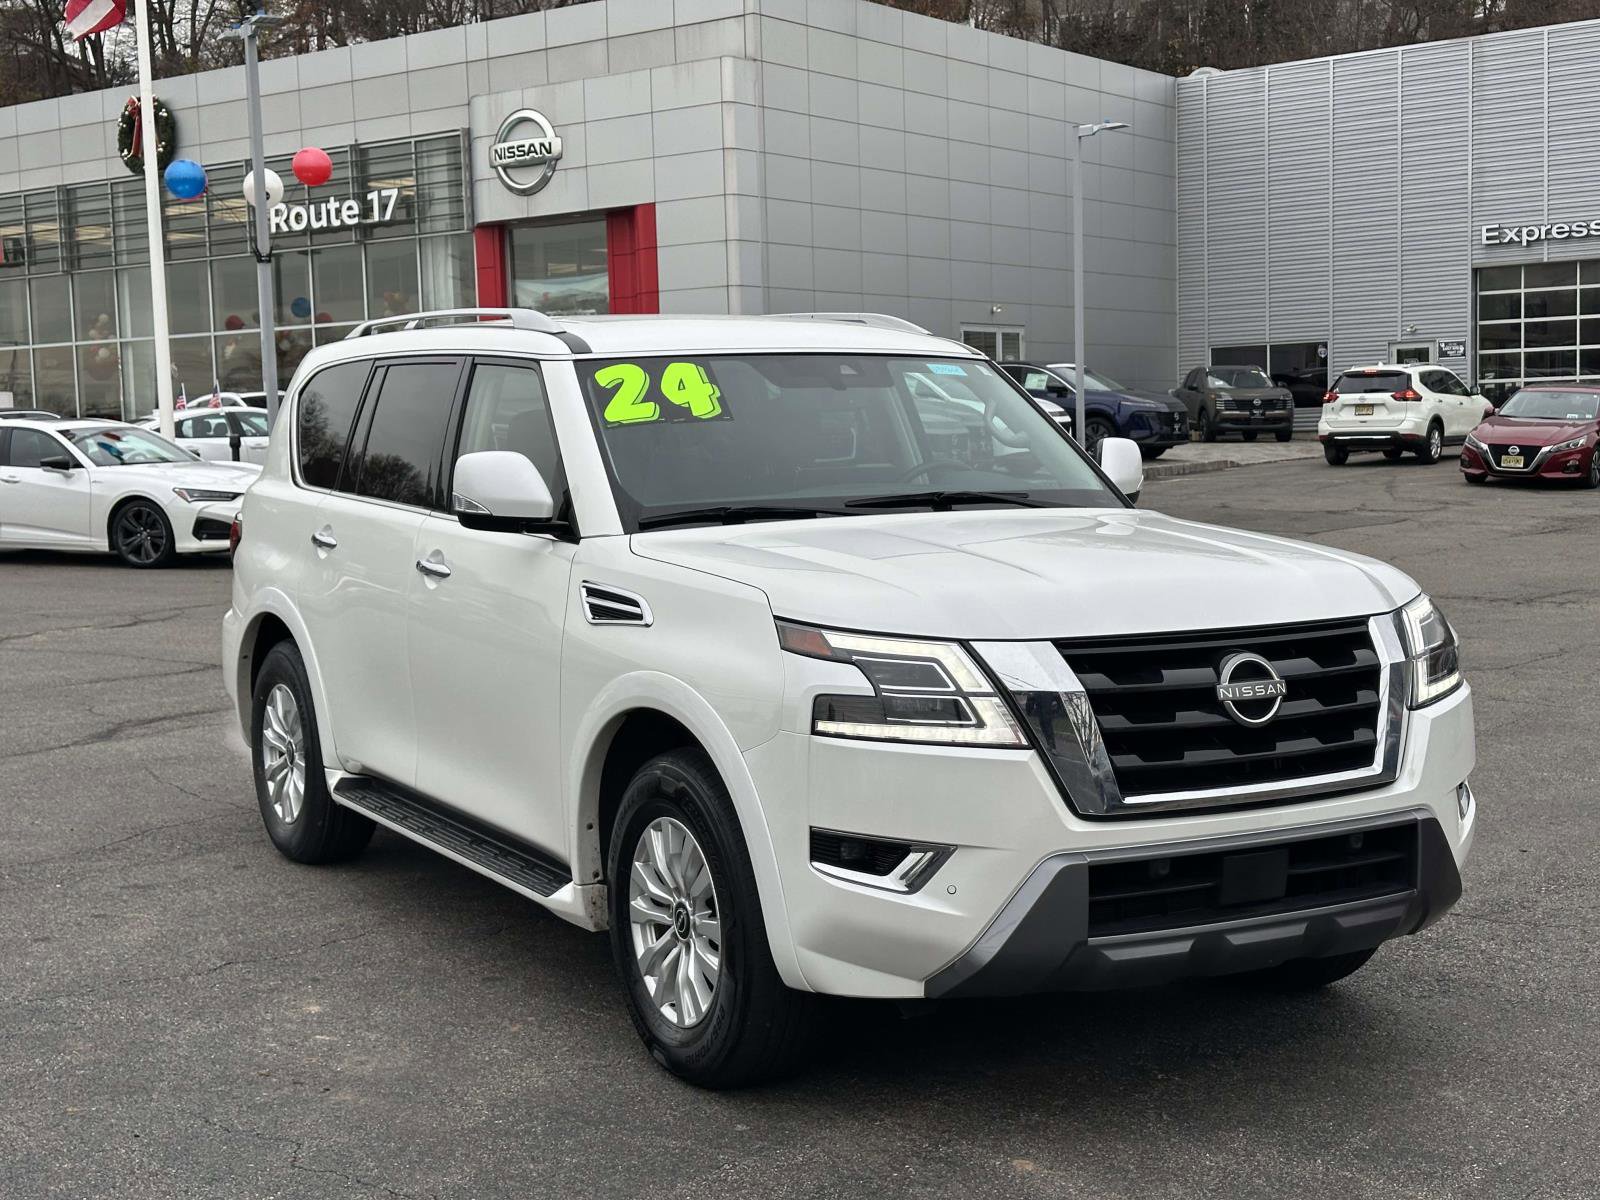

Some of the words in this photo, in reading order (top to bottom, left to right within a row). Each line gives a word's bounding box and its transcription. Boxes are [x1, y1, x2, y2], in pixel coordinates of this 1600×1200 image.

[494, 141, 552, 161] NISSAN
[269, 196, 360, 233] Route
[366, 188, 399, 221] 17
[1481, 219, 1600, 246] Express
[594, 362, 721, 424] 24
[1219, 683, 1286, 698] NISSAN
